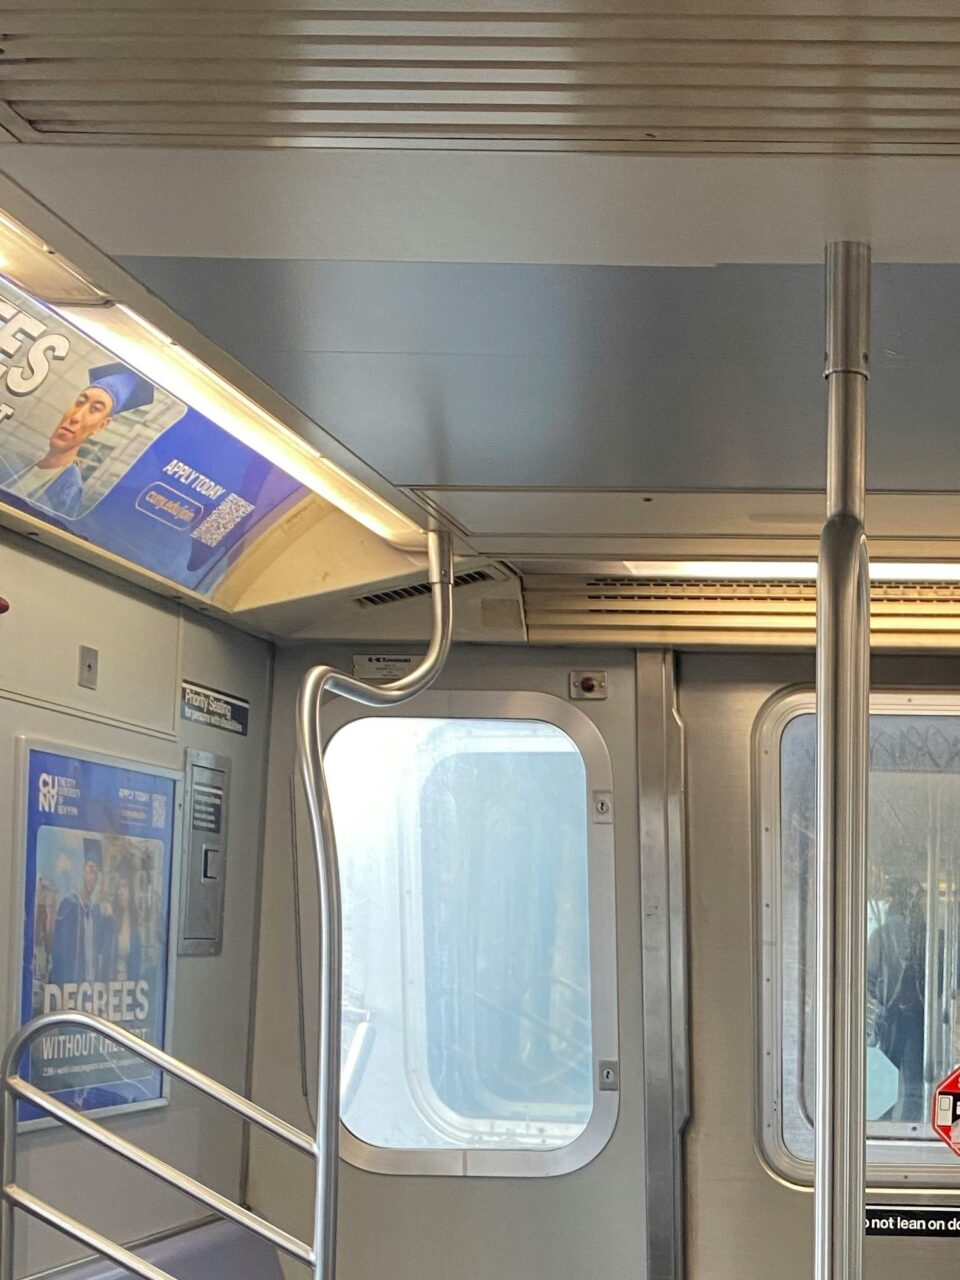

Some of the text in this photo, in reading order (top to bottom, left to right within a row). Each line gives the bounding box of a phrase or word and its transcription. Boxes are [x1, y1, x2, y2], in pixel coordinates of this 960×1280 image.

[162, 459, 226, 500] APPLY TODAY
[185, 688, 232, 720] Priority Seating
[39, 772, 58, 792] CU
[38, 791, 57, 813] NY
[43, 980, 149, 1021] DEGREES
[43, 1032, 97, 1060] WITHOUT
[871, 1217, 894, 1230] not
[897, 1217, 926, 1230] lean
[928, 1220, 945, 1230] on
